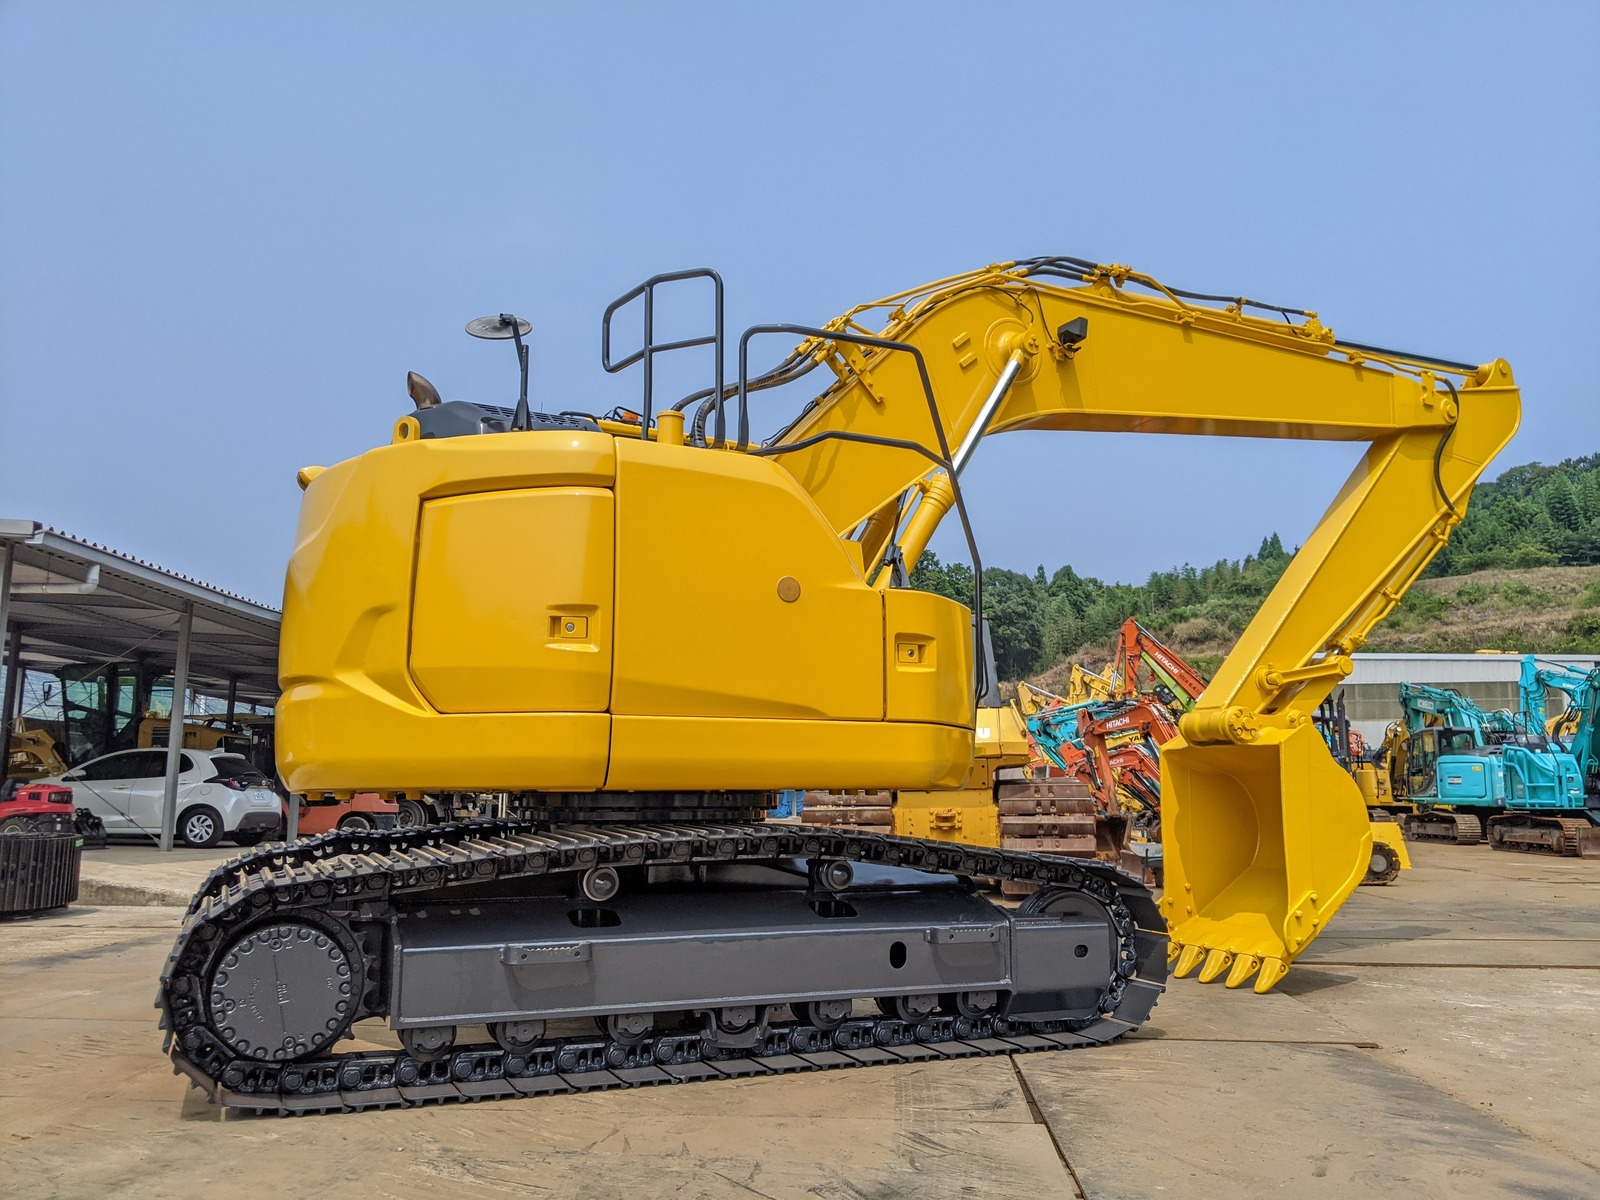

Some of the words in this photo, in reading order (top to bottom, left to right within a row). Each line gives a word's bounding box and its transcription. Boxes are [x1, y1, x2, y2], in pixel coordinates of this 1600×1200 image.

[1154, 652, 1179, 674] HITACHI
[1106, 717, 1130, 729] HITACHI
[977, 727, 991, 739] U
